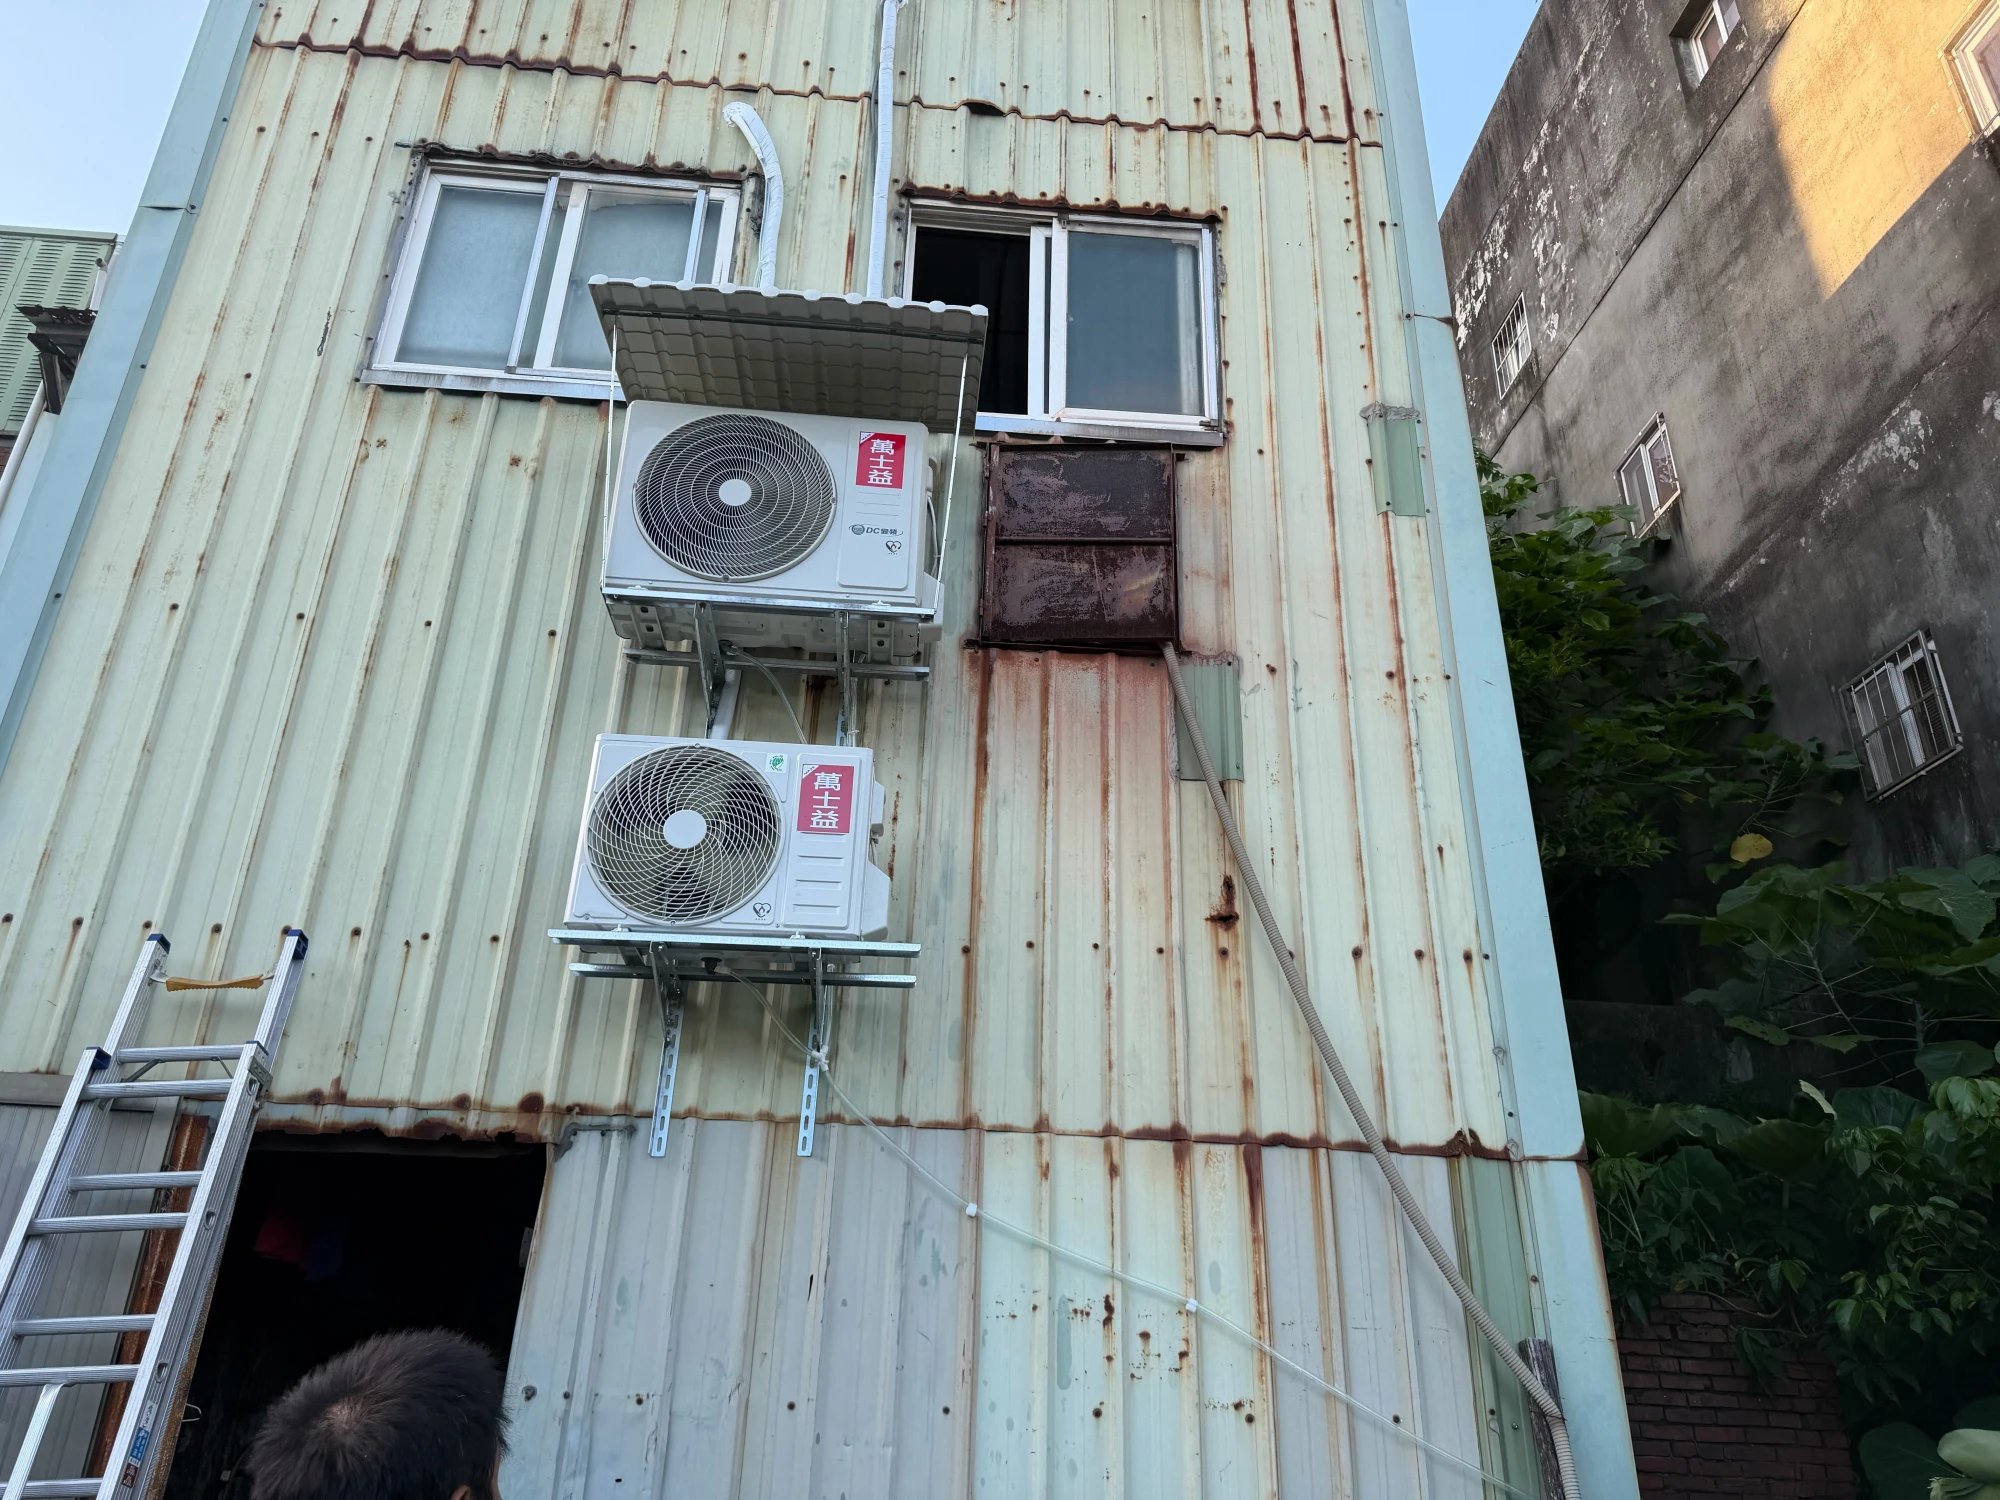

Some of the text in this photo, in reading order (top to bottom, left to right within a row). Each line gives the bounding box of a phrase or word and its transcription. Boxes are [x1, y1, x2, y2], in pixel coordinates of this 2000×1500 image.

[868, 439, 896, 486] 萬士益
[810, 772, 842, 829] 萬士益
